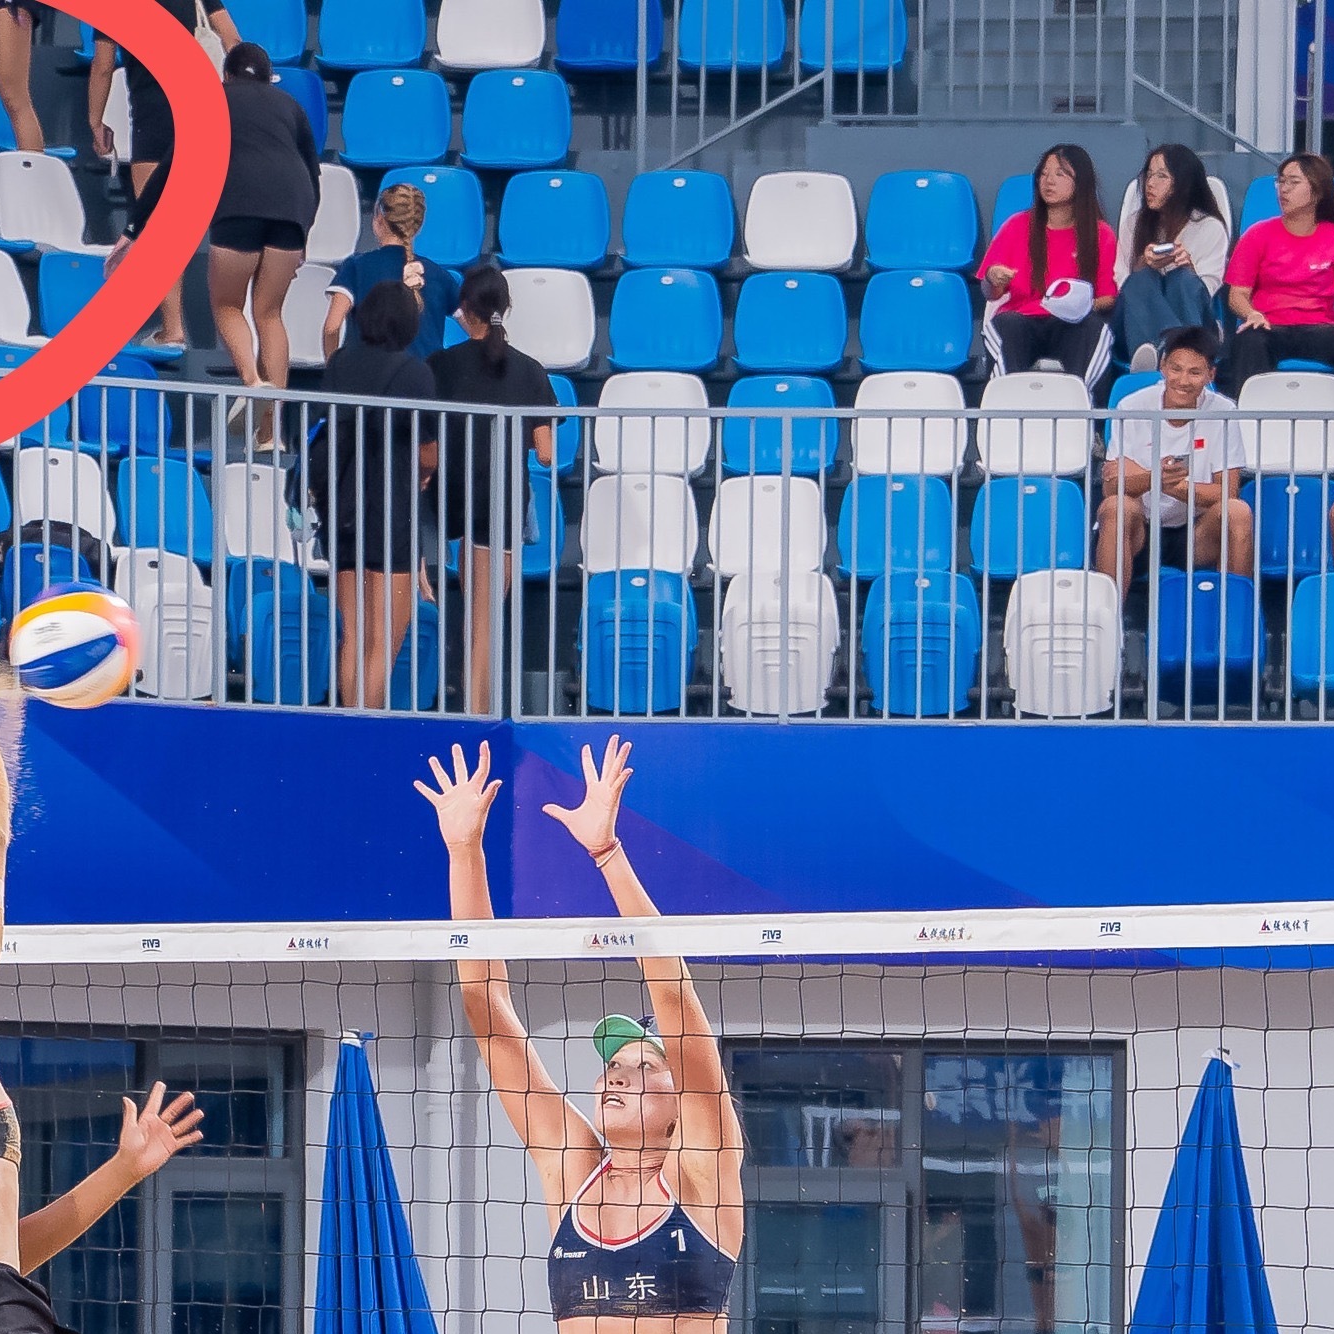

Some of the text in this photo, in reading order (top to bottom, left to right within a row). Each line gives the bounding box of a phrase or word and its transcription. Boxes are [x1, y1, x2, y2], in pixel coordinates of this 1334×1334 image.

[1100, 922, 1120, 932] FIVB
[450, 934, 468, 944] FIVB
[762, 930, 781, 939] FIVB
[142, 938, 160, 949] FIVB
[670, 1229, 687, 1251] 1
[582, 1272, 658, 1300] 山东
